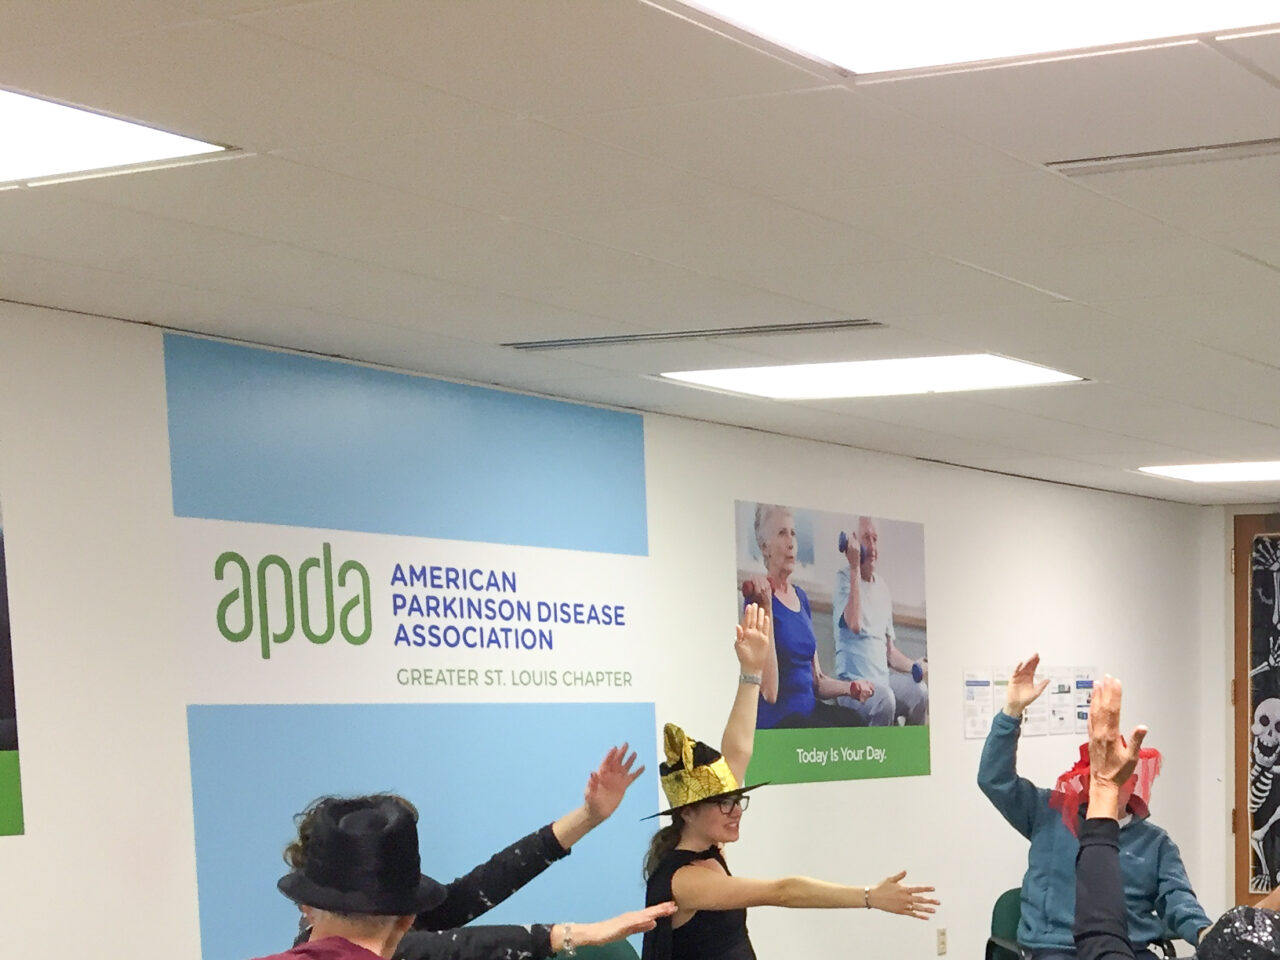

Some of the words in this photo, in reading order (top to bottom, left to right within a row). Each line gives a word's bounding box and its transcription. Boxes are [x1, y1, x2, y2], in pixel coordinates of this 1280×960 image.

[390, 563, 517, 593] AMERICAN
[214, 541, 373, 660] apda
[392, 593, 532, 622] PARKINSON
[537, 601, 626, 626] DISEASE
[394, 623, 554, 650] ASSOCIATION
[396, 667, 479, 687] GREATER
[484, 669, 507, 687] ST.
[511, 669, 558, 687] LOUIS
[562, 670, 633, 687] CHAPTER
[796, 747, 828, 766] Today
[830, 747, 839, 762] Is
[840, 746, 865, 761] Your
[866, 745, 887, 763] Day.
